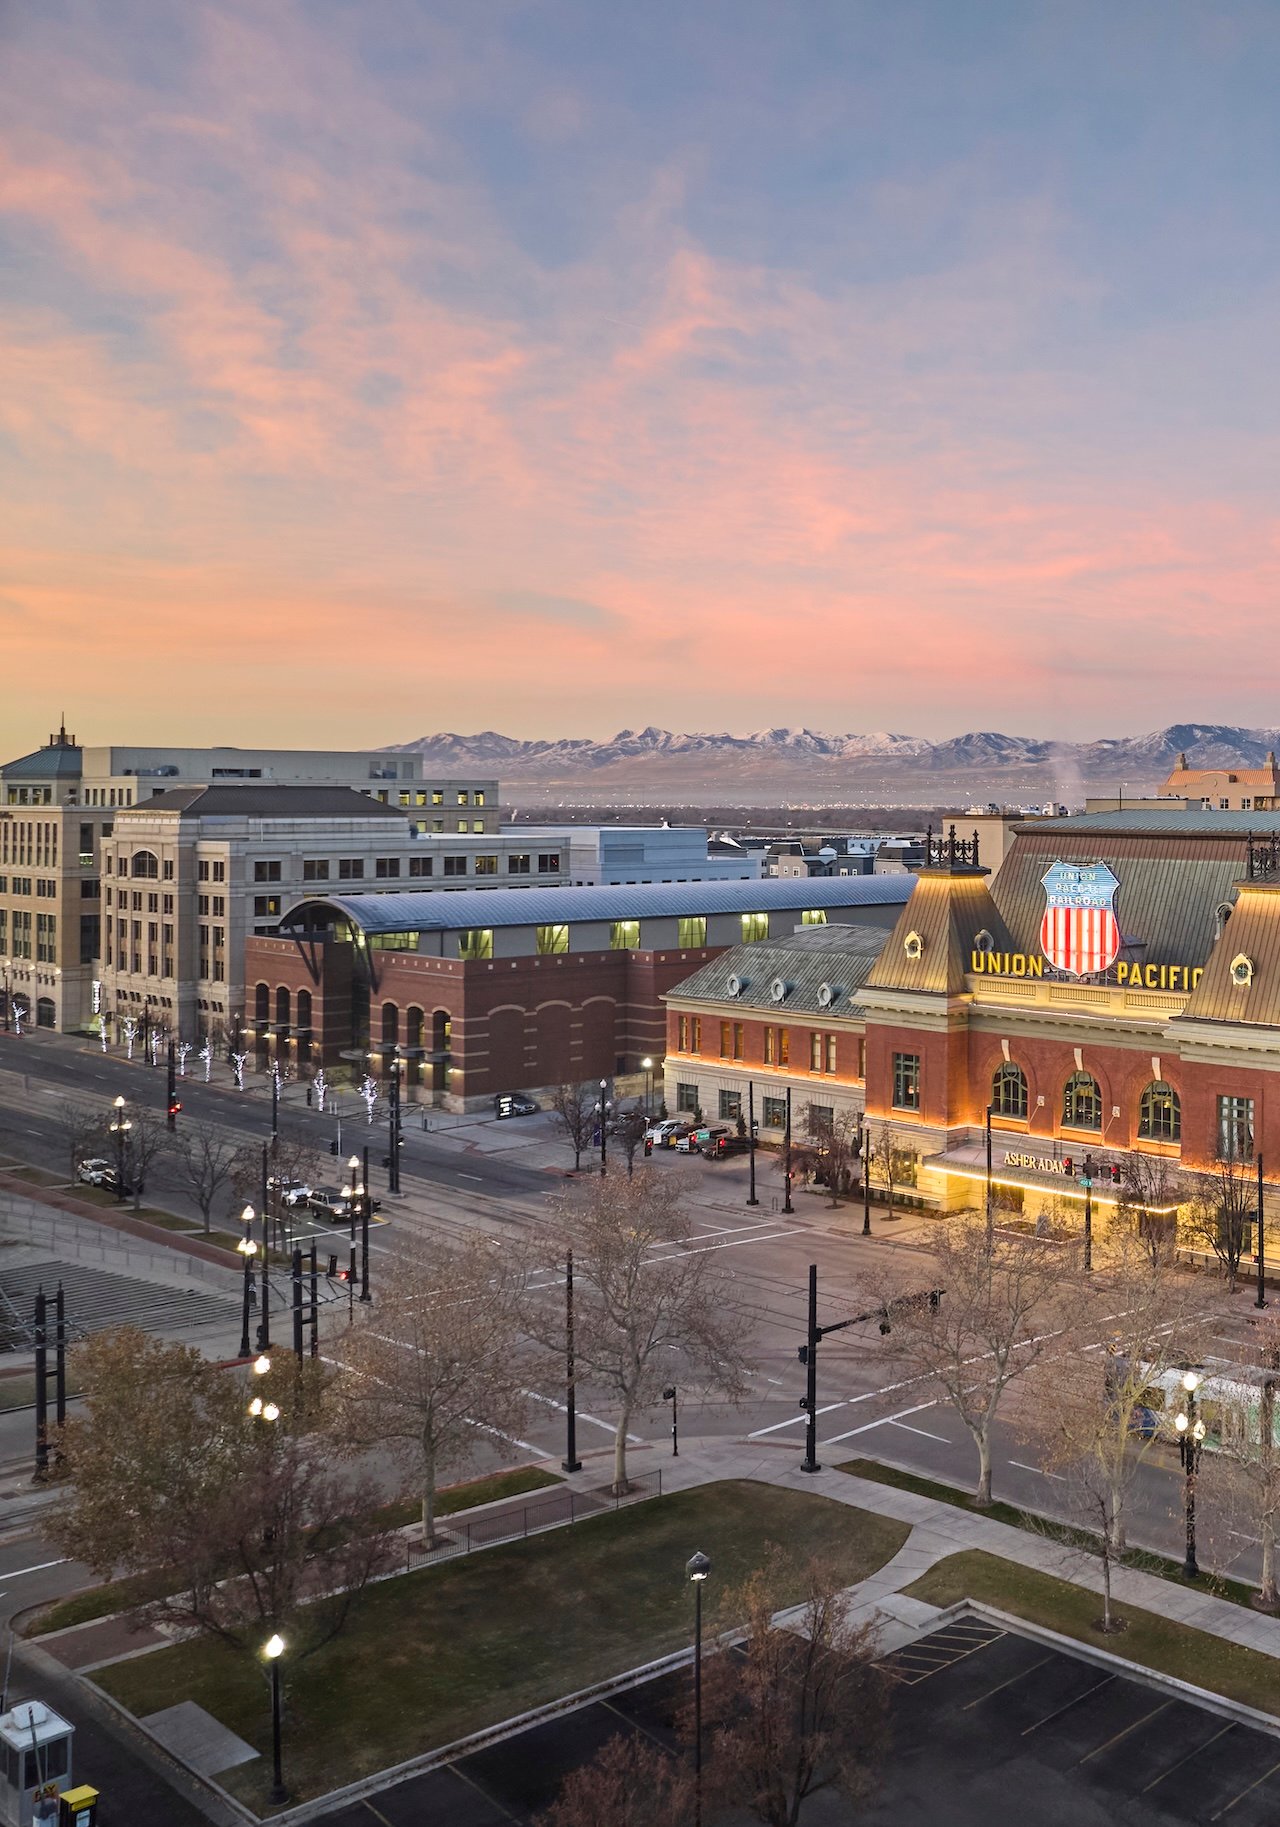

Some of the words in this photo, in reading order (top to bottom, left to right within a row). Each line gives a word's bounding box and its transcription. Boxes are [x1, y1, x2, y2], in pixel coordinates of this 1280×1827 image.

[1060, 872, 1096, 881] UNION
[1049, 895, 1106, 906] RAILROAD
[971, 950, 1043, 977] UNION
[1004, 1151, 1037, 1170] ASHER
